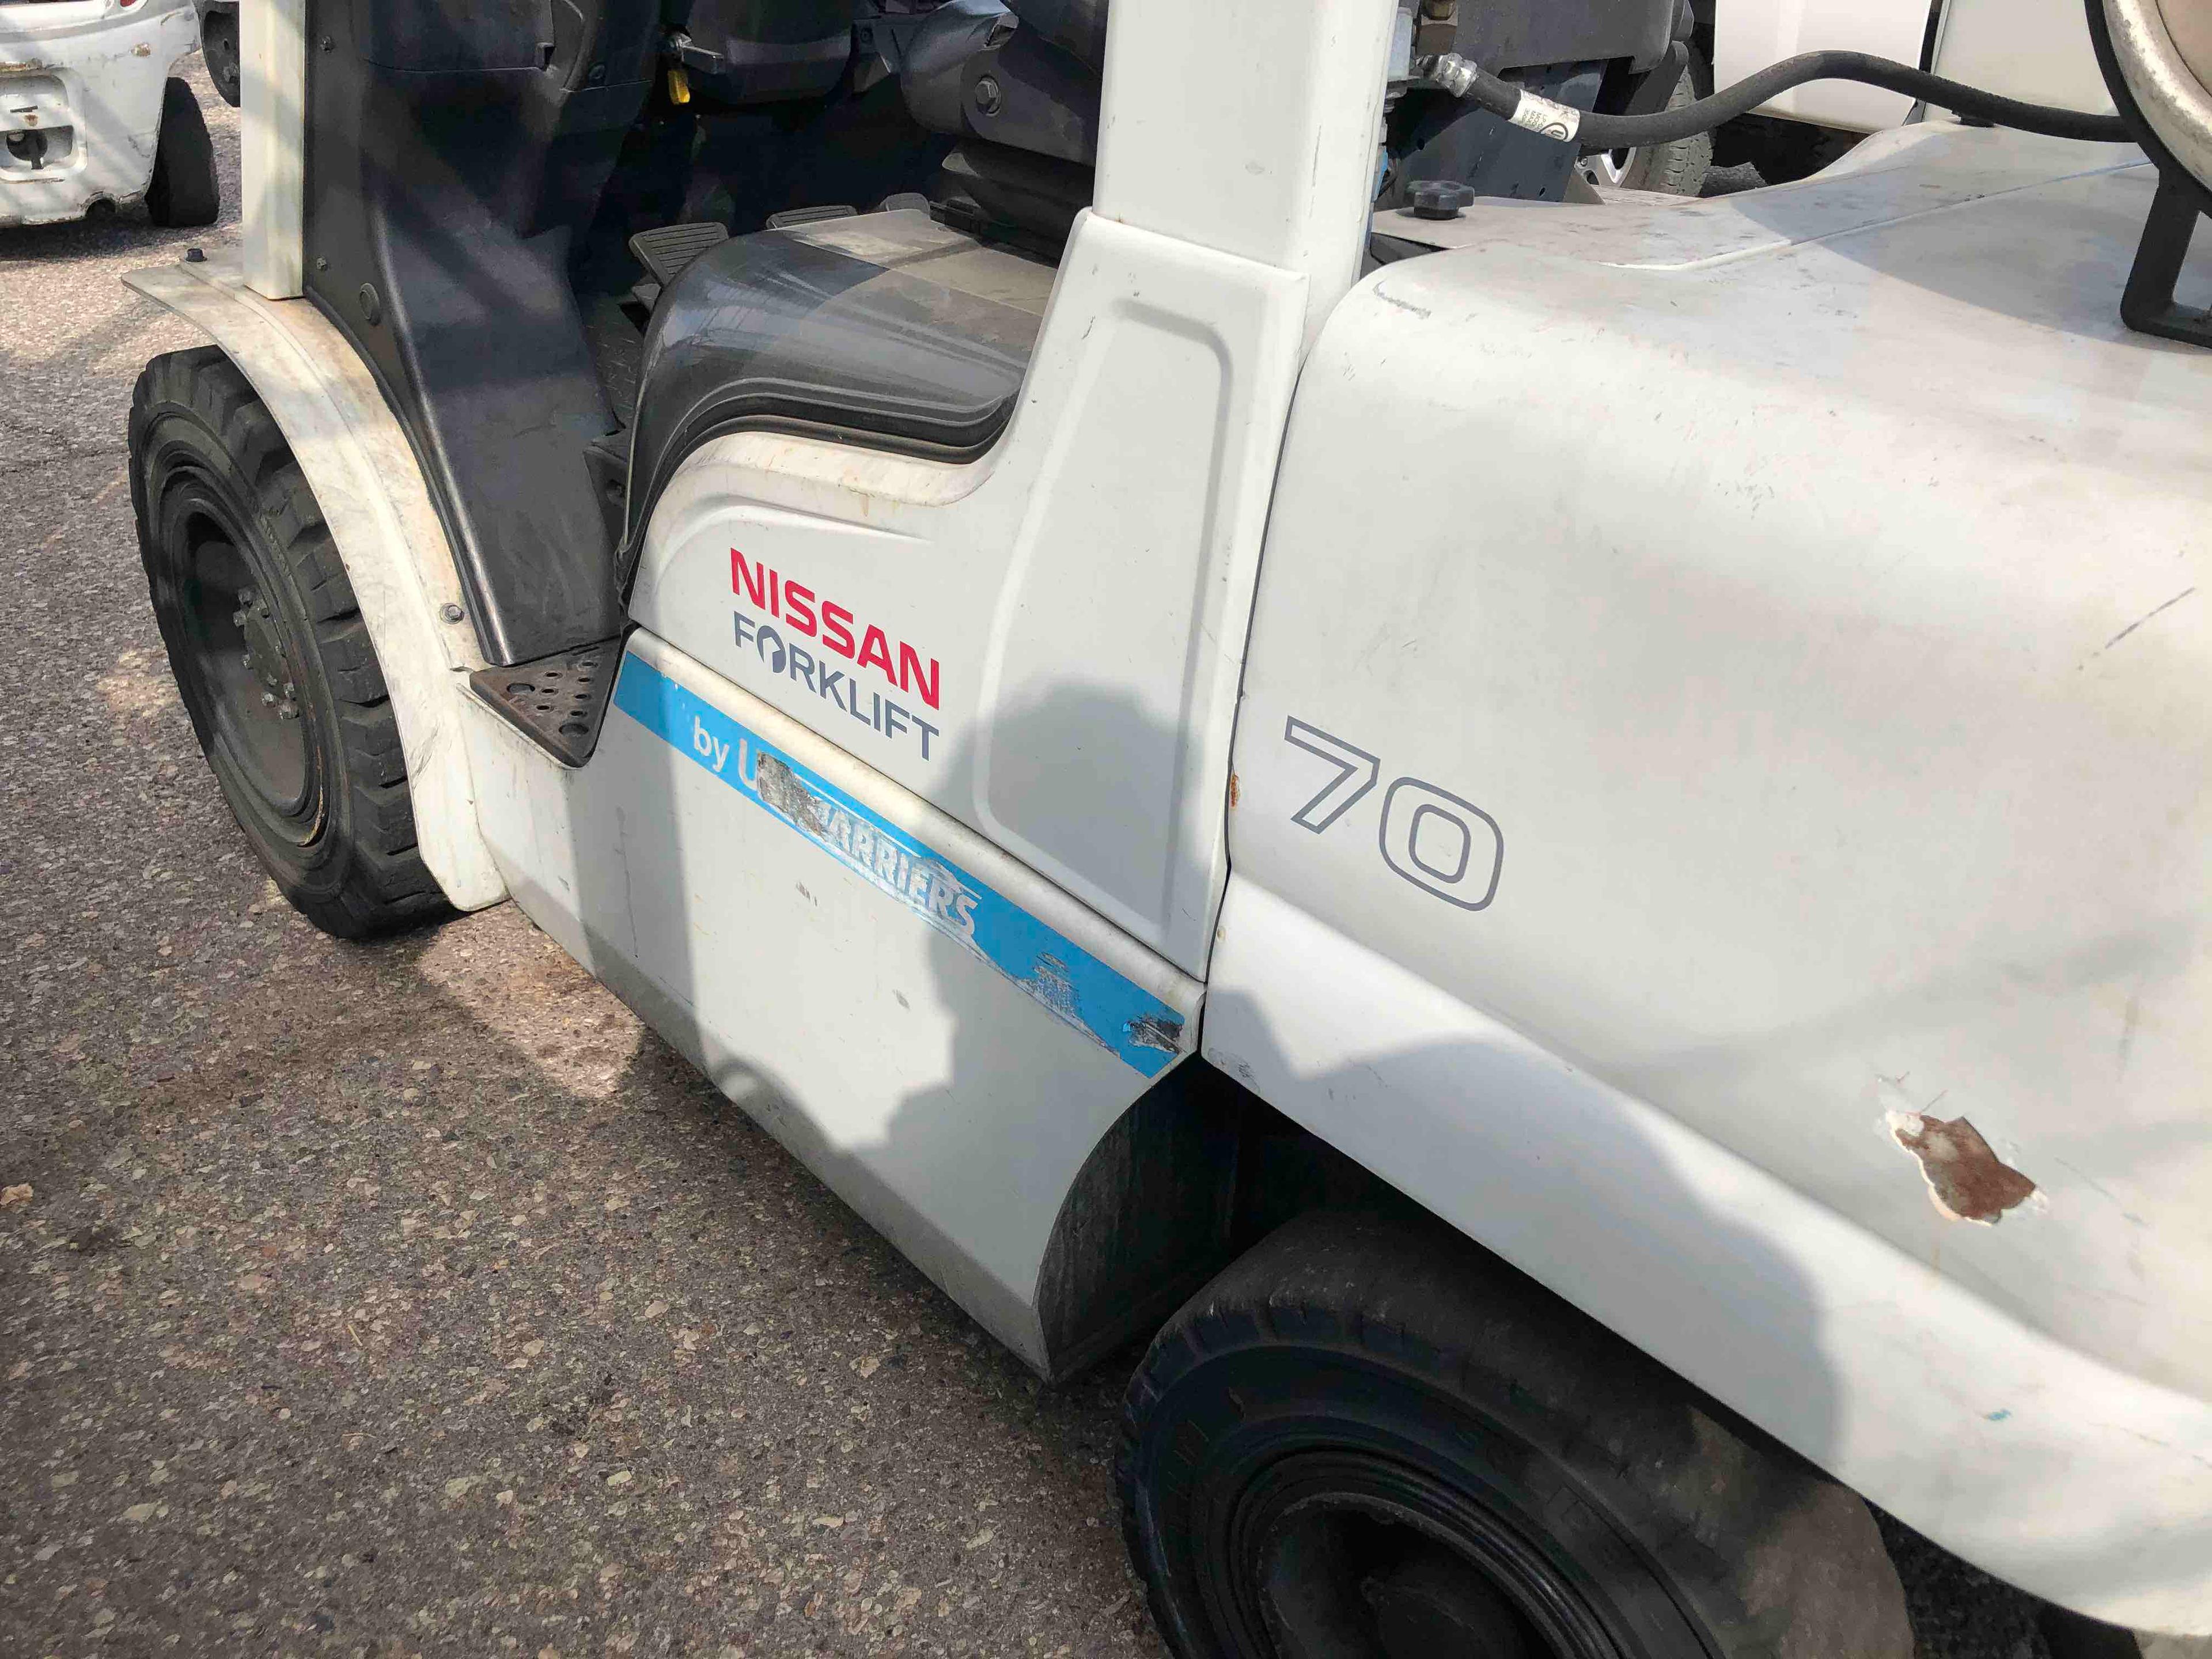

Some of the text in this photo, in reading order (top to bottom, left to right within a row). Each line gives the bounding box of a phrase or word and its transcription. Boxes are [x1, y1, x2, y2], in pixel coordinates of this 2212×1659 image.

[730, 547, 940, 711] NISSAN
[733, 611, 940, 762] FORKLIFT
[694, 715, 729, 772] by
[1284, 715, 1504, 911] 70
